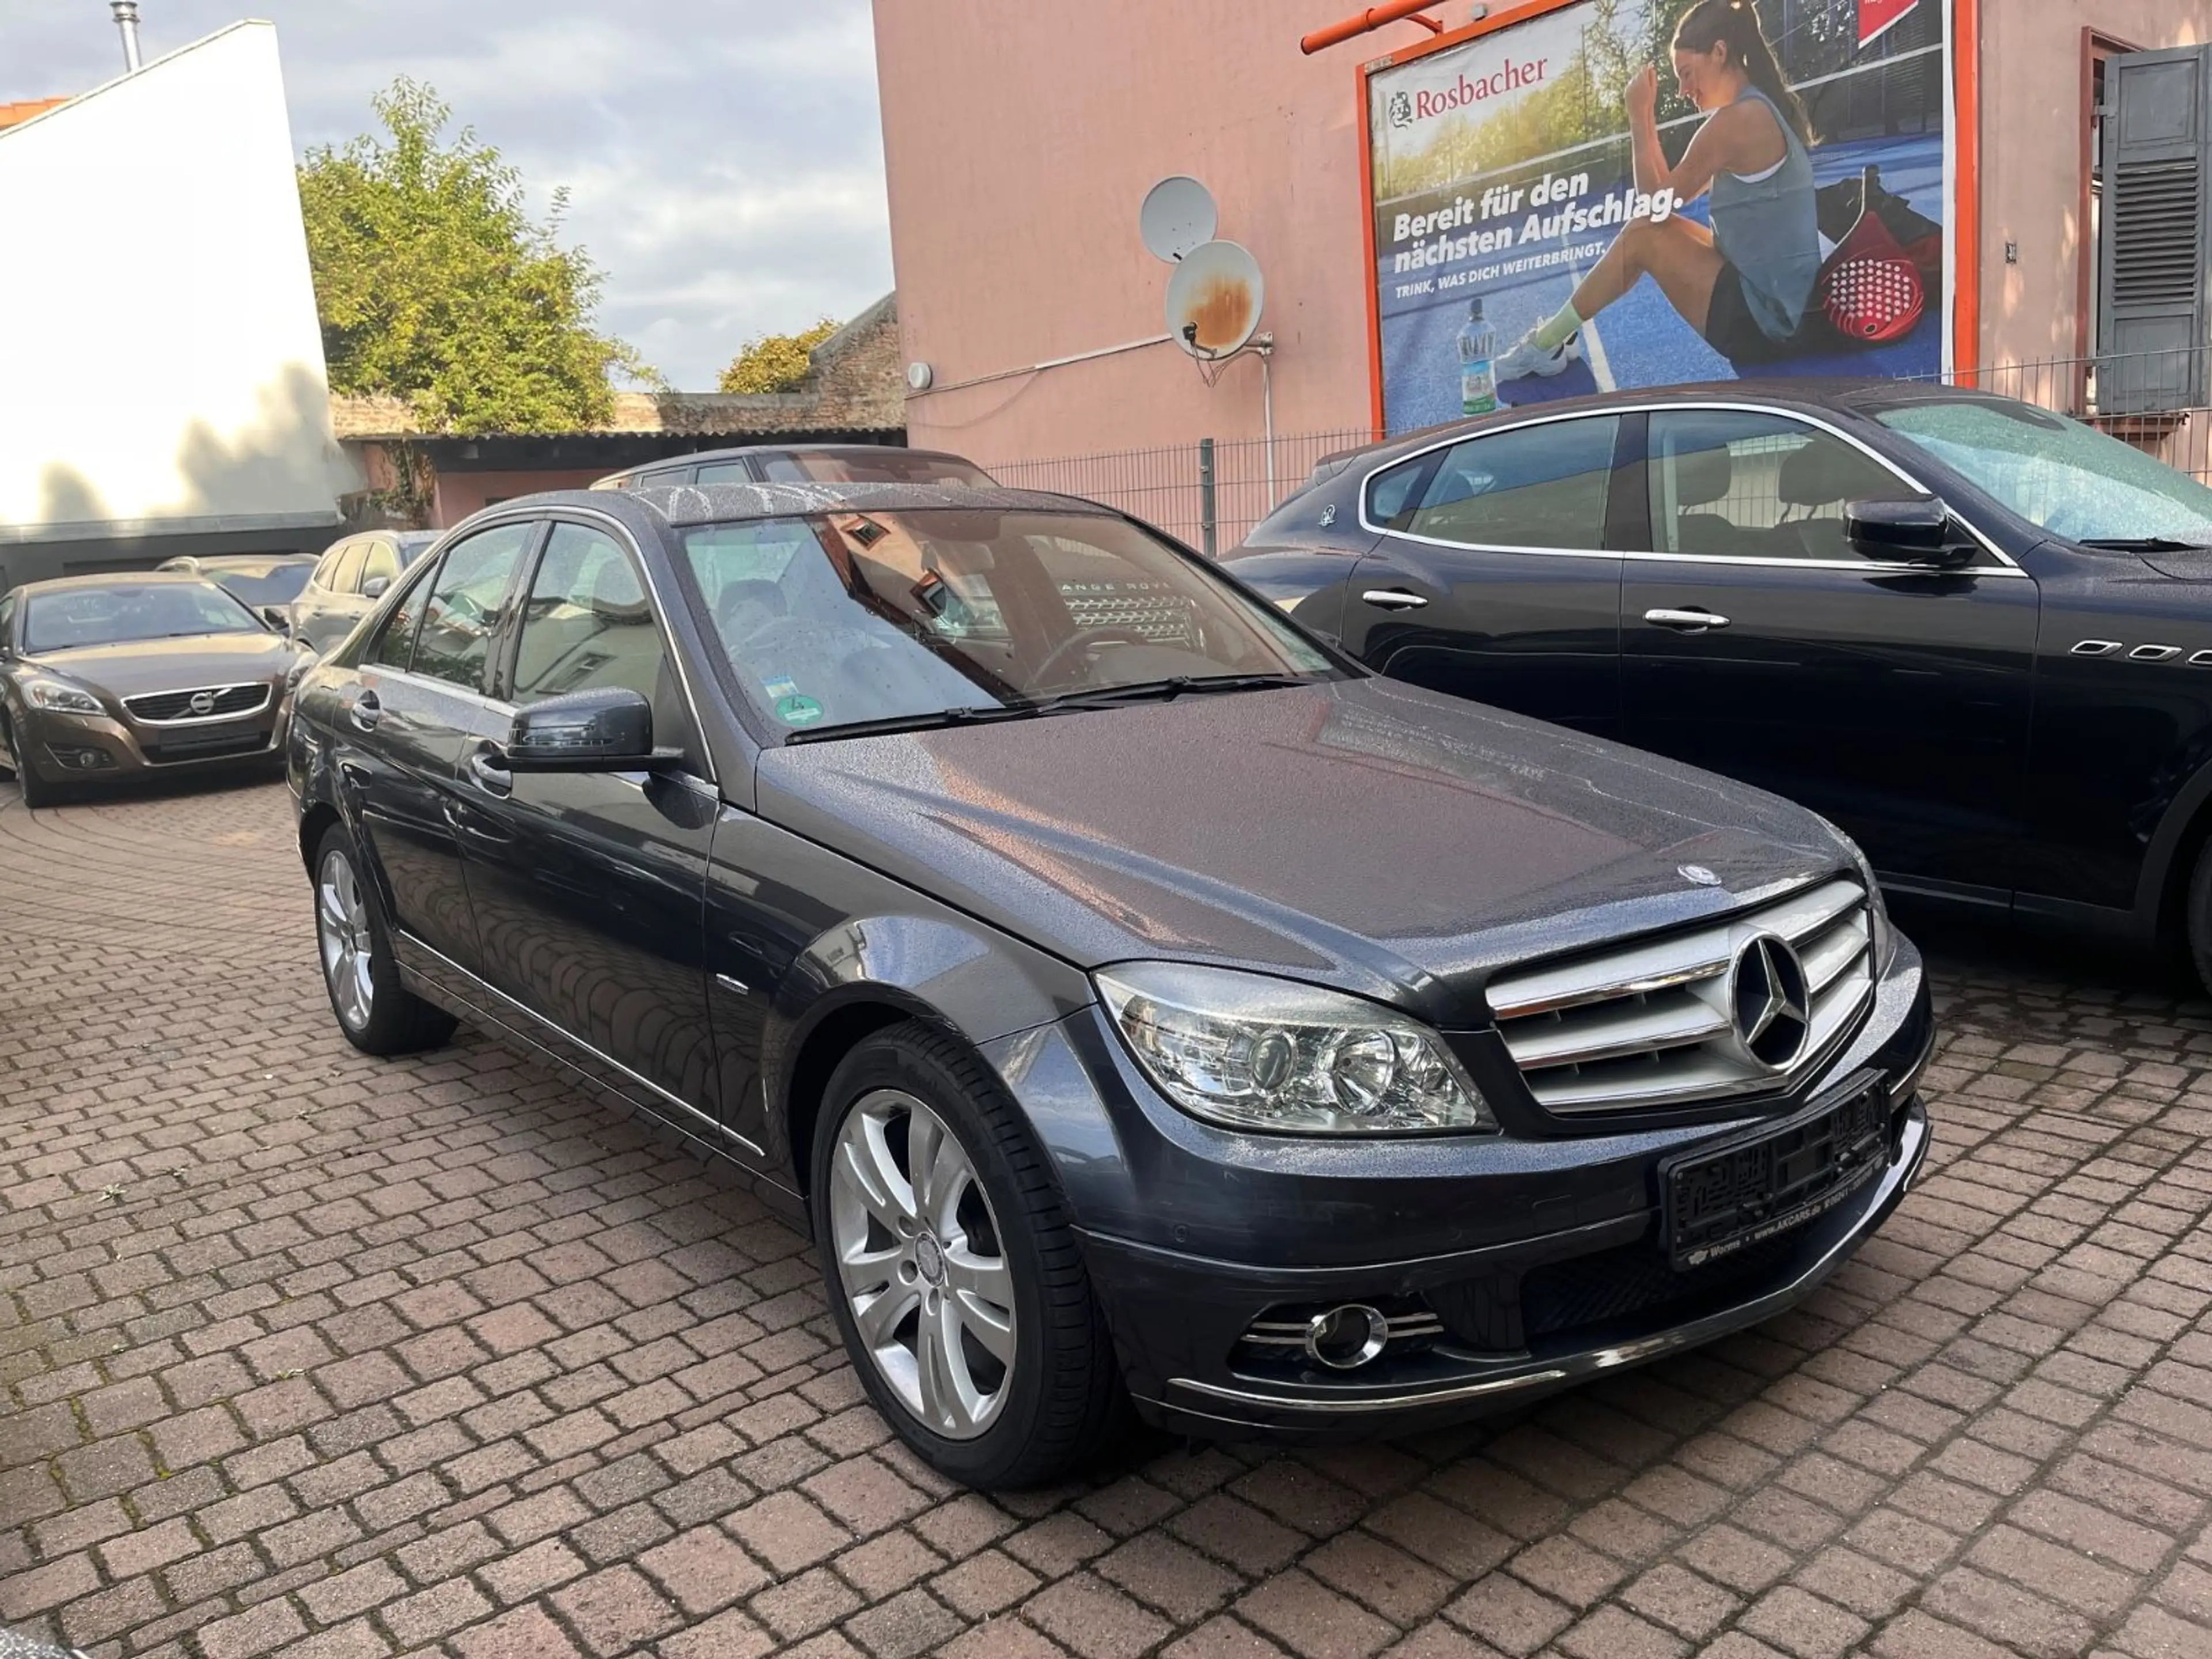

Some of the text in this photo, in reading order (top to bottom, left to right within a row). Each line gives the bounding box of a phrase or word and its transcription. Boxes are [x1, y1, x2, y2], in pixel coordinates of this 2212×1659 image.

[1416, 58, 1548, 119] Rosbacher
[1393, 172, 1589, 242] Bereit für den
[1395, 187, 1683, 274] nächsten Aufschlag.
[1396, 242, 1606, 298] TRINK, WAS DICH WEITERBRINGT.
